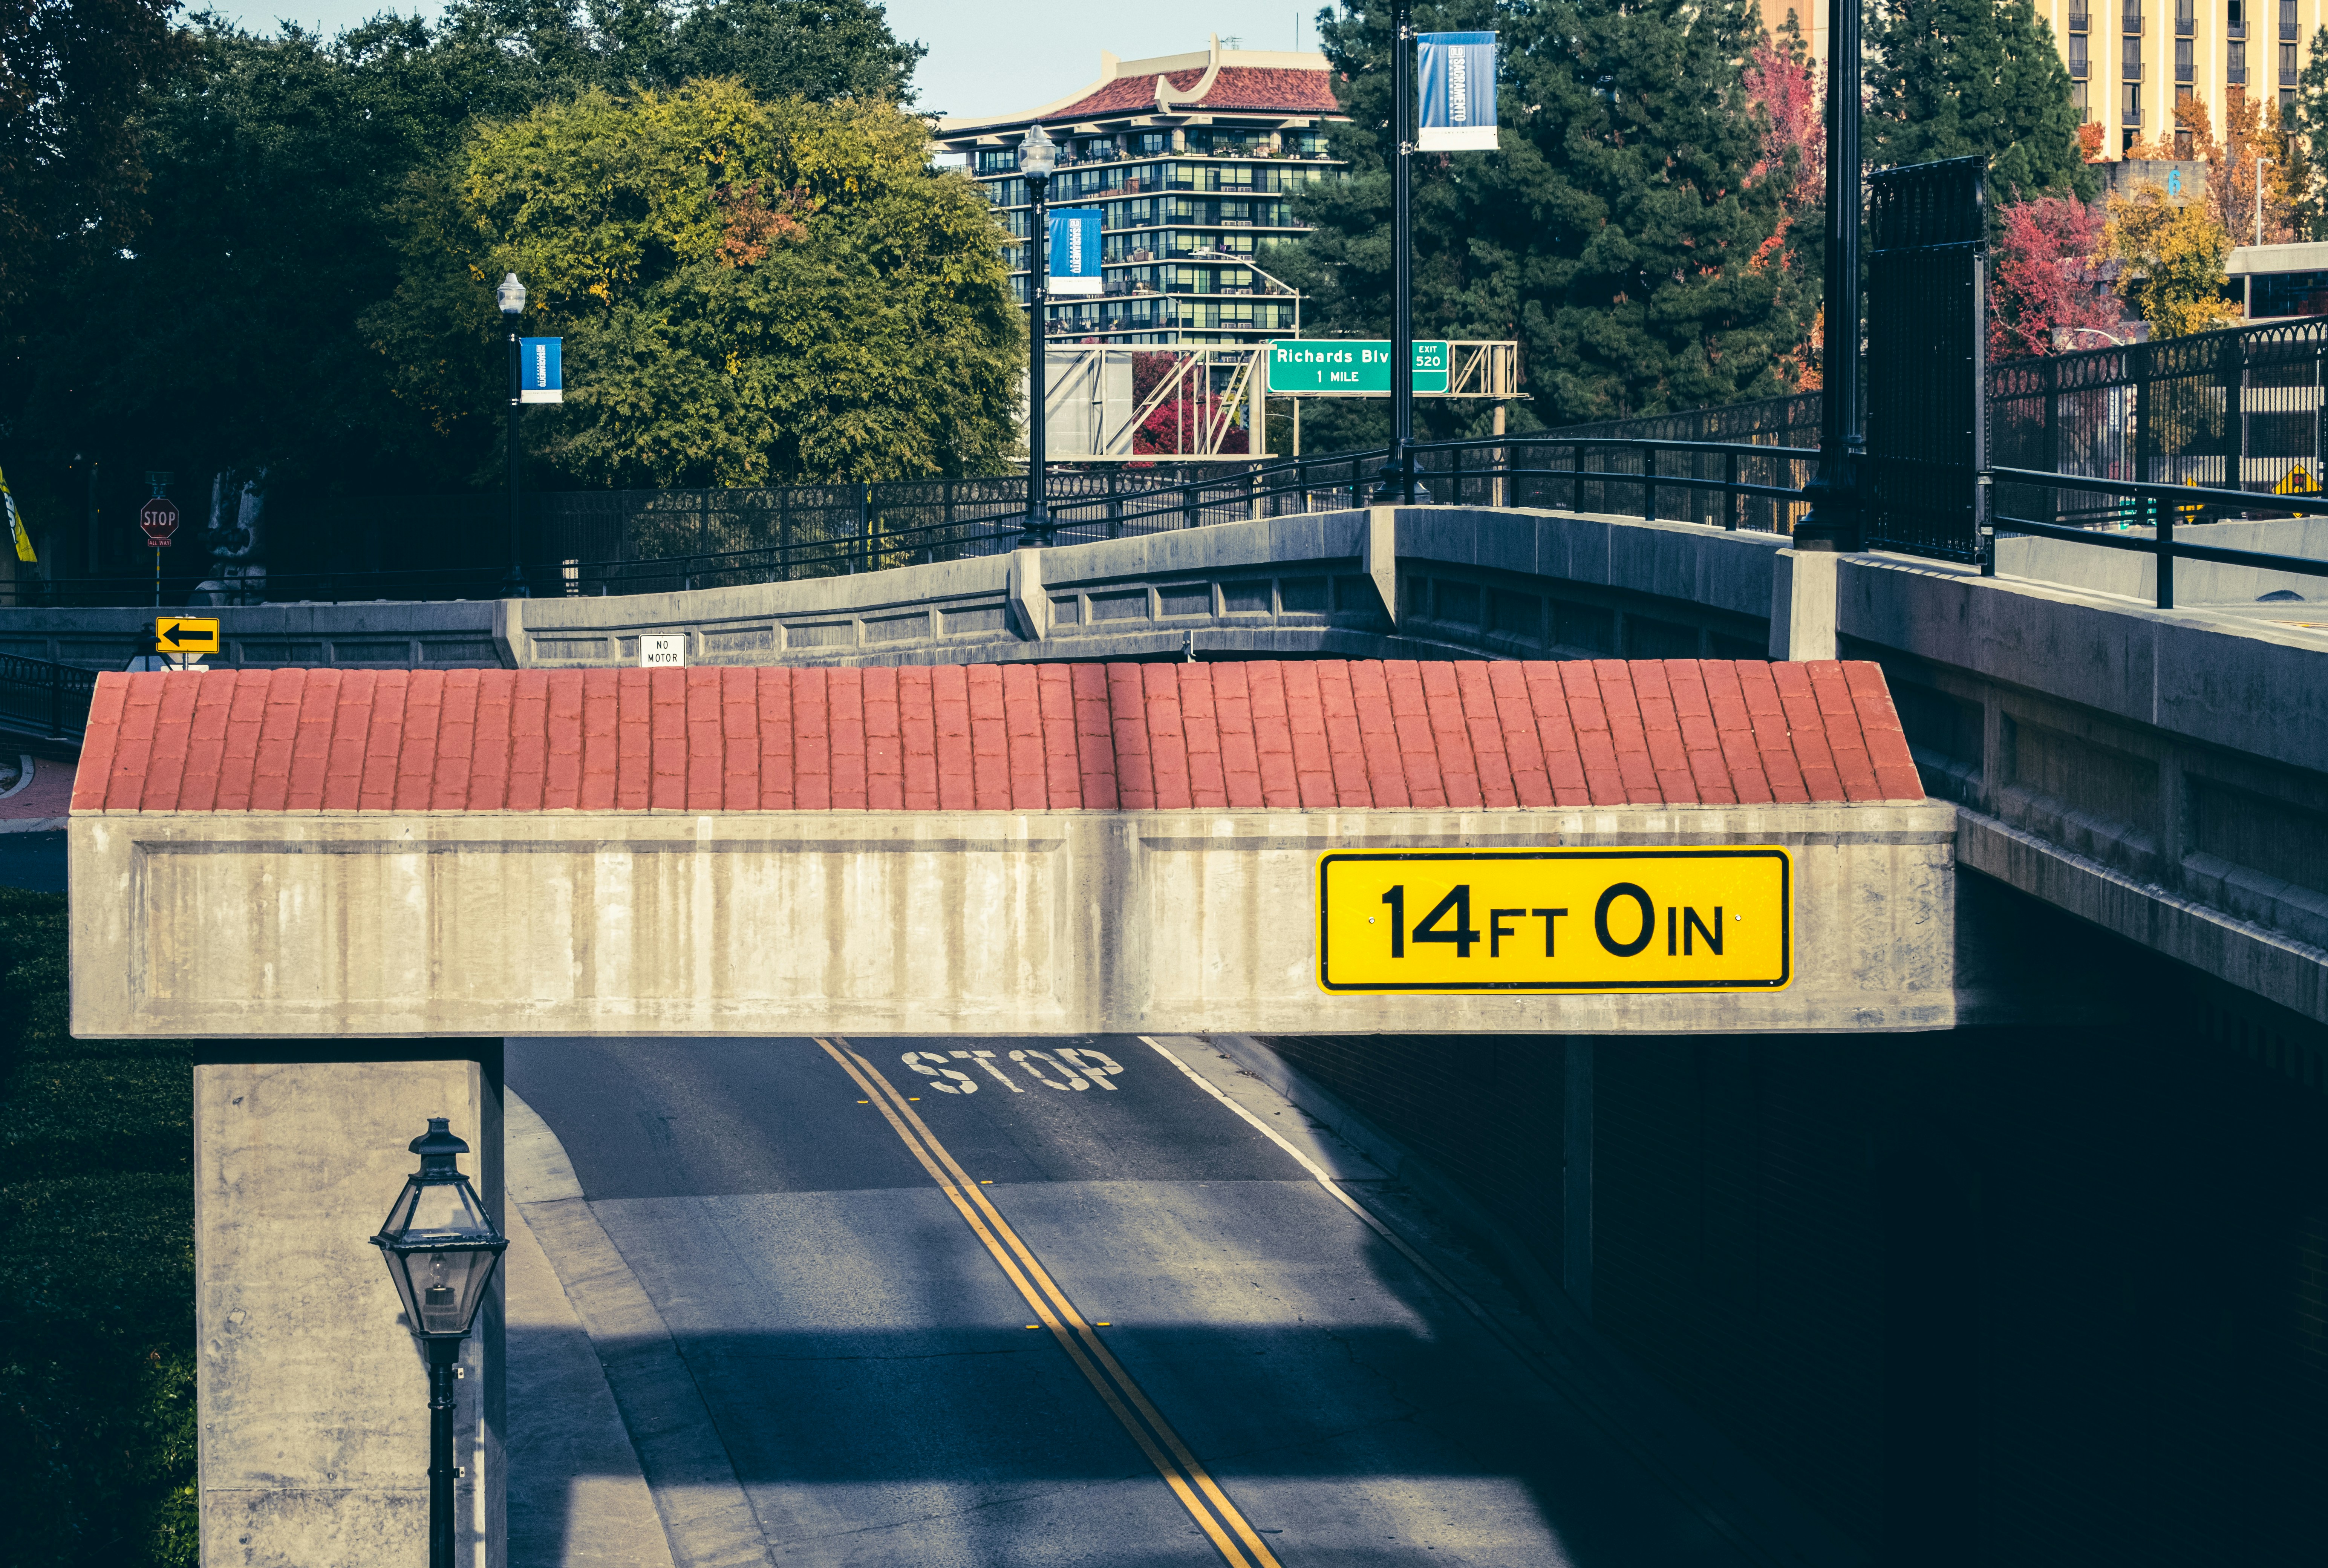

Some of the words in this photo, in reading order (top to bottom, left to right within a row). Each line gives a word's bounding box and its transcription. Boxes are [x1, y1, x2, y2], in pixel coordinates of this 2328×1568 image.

[1453, 58, 1466, 122] SACRAMENTO
[2168, 170, 2181, 196] 6
[1073, 228, 1082, 273] SACRAMENTO
[1277, 349, 1353, 363] Richards
[1362, 349, 1389, 363] Blv
[1416, 356, 1440, 367] 520
[1317, 371, 1322, 383] 1
[1330, 372, 1359, 382] MILE
[144, 511, 176, 526] STOP
[657, 640, 668, 649] NO
[648, 653, 677, 662] MOTOR
[901, 1048, 1124, 1095] STOP
